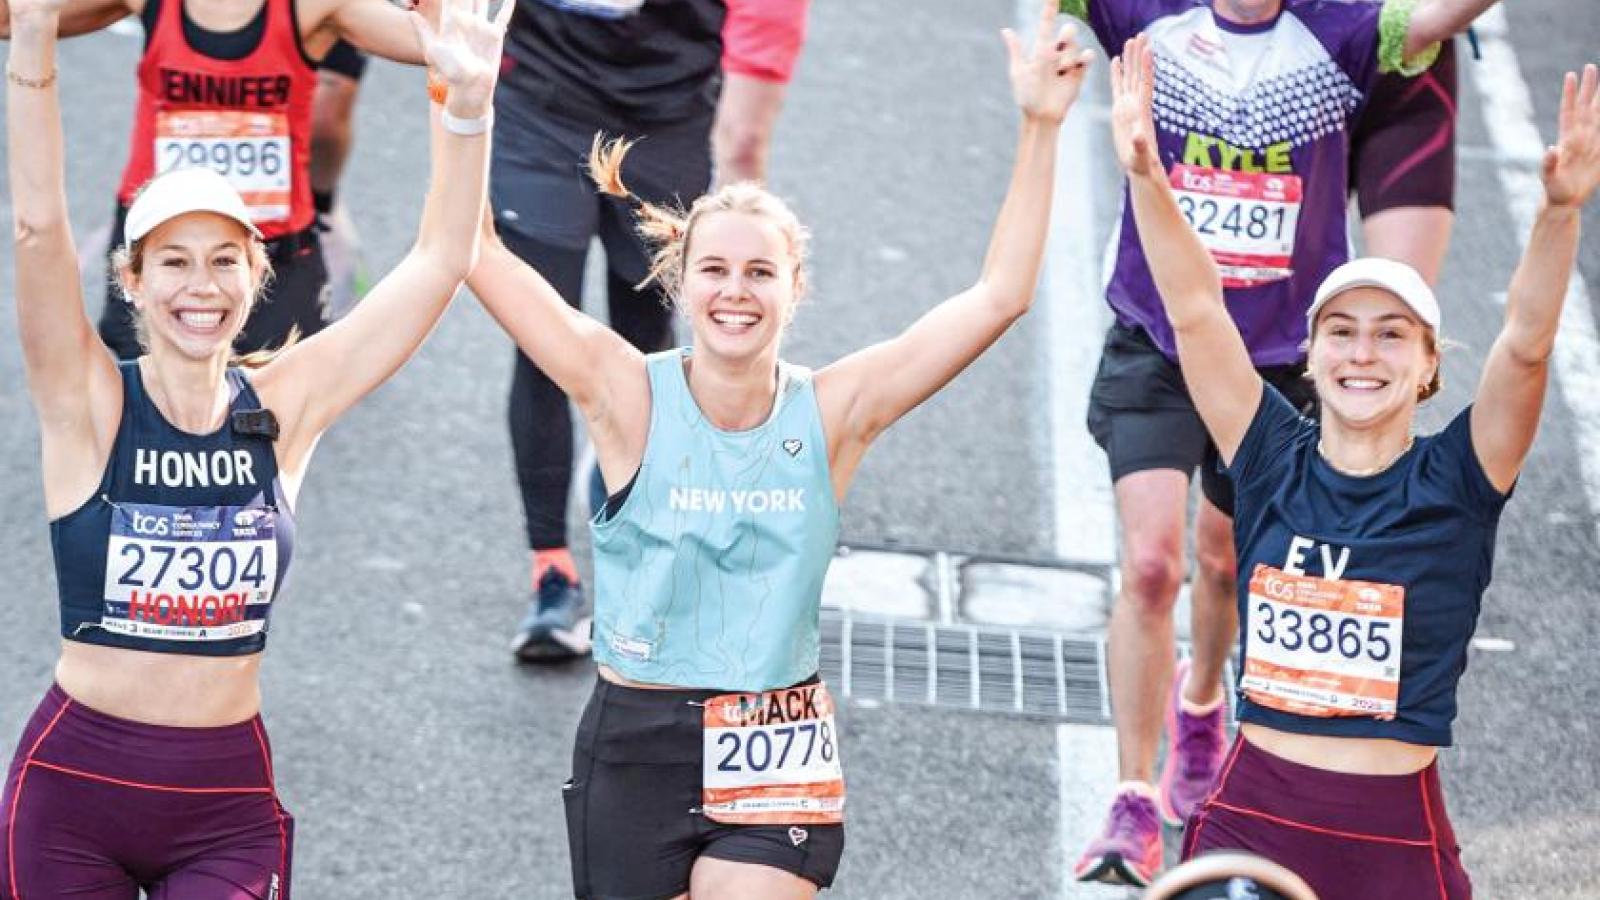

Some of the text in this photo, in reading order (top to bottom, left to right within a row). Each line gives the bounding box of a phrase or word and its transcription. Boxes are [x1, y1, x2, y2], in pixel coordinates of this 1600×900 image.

[167, 141, 281, 176] 29996
[1183, 132, 1293, 172] KYLE
[1178, 196, 1286, 241] 32481
[134, 448, 256, 487] HONOR
[669, 487, 805, 513] NEW YORK
[133, 511, 168, 536] tcs
[118, 543, 266, 590] 27304
[1282, 534, 1351, 582] EV
[1257, 602, 1391, 662] 33865
[740, 688, 820, 727] MACK
[718, 721, 834, 772] 20778
